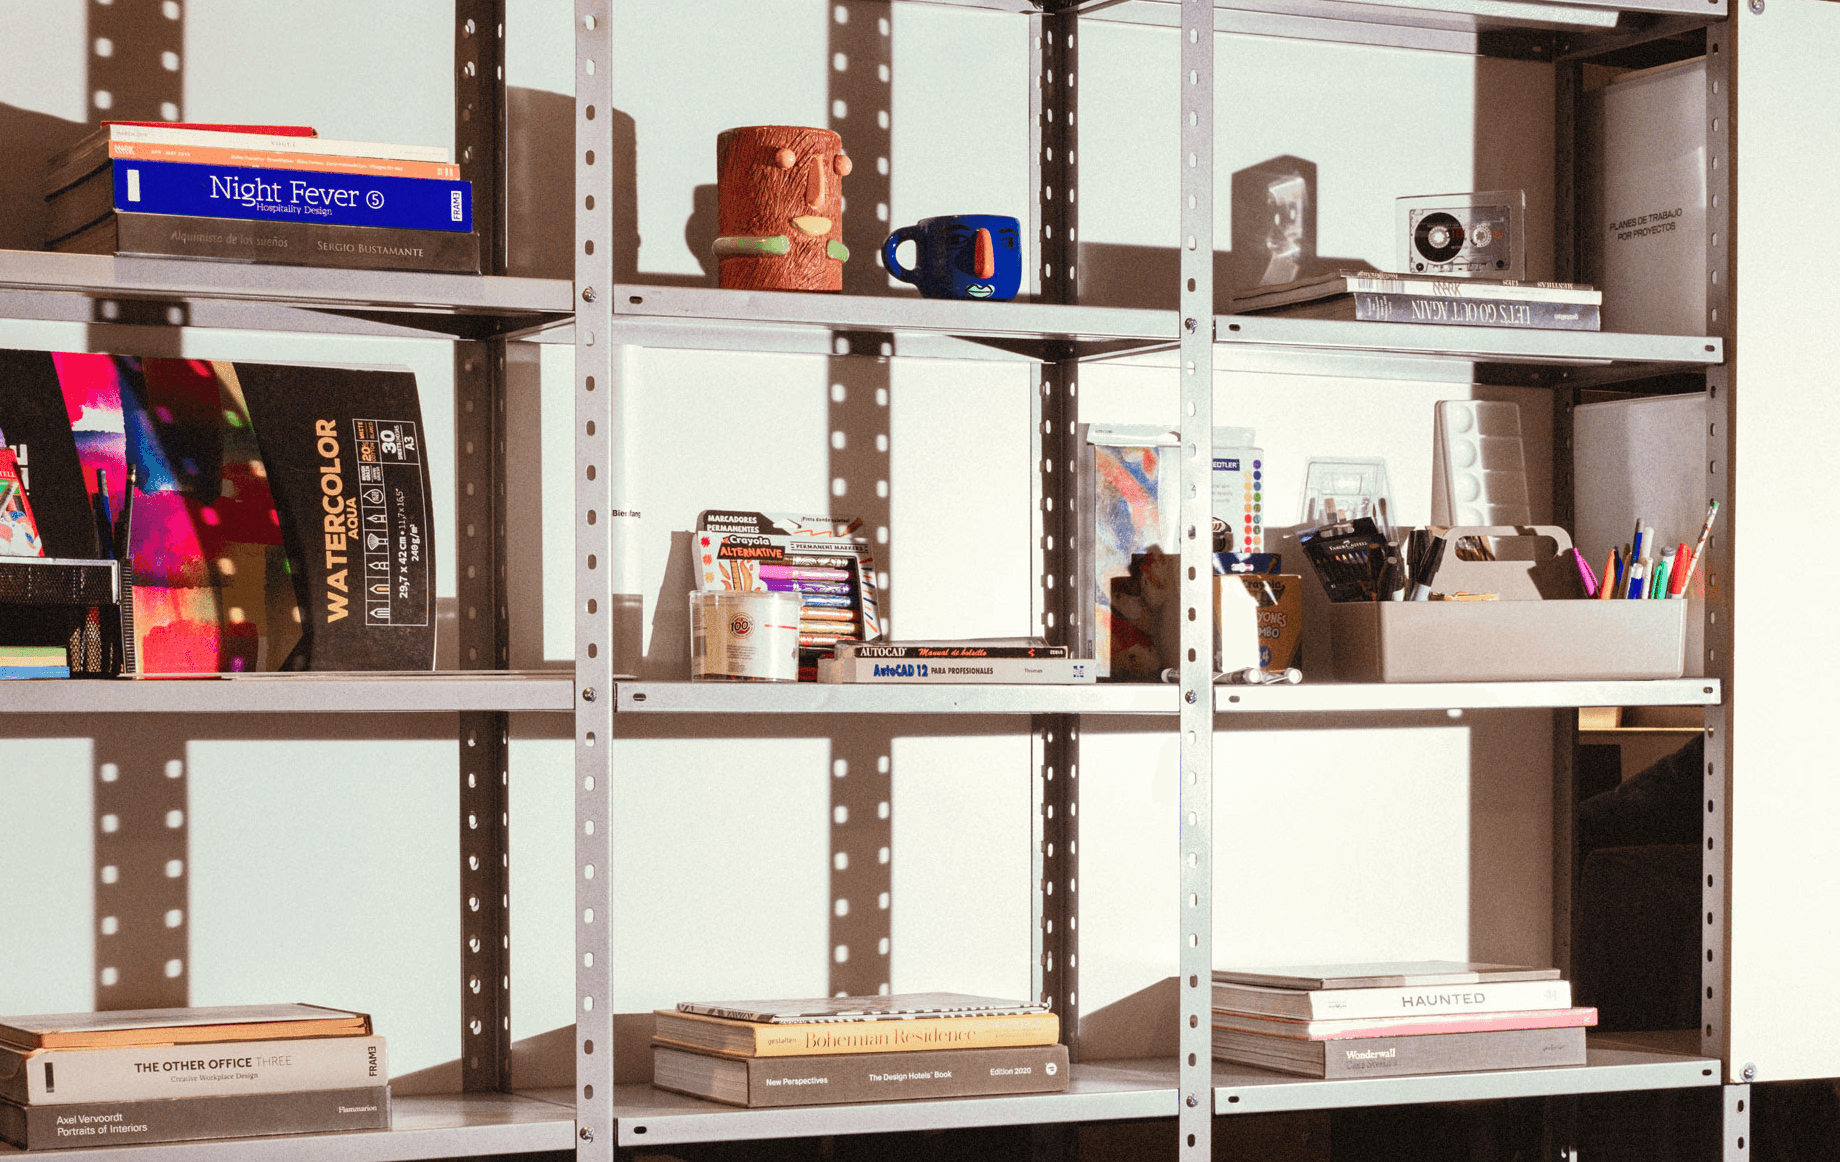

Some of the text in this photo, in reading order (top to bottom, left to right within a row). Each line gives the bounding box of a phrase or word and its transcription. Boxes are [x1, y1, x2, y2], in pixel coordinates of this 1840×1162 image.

[209, 175, 281, 207] Night
[289, 180, 360, 207] Fever
[256, 202, 333, 217] Hospitality Design
[453, 192, 462, 221] FRAME
[1609, 208, 1683, 231] PLANES DE TRABAJO
[1617, 221, 1676, 241] POR PROYECTOS
[358, 244, 424, 258] BUSTAMANTE
[1412, 300, 1449, 320] AGAIN
[1451, 302, 1478, 323] OUT
[1481, 303, 1497, 323] GO
[1500, 305, 1531, 325] LET'S
[380, 429, 397, 454] 30
[404, 436, 415, 451] A3
[315, 419, 349, 624] WATERCOLOR
[347, 497, 359, 540] AQUA
[707, 514, 758, 525] MARCADORES
[706, 524, 760, 534] PERMANENTES
[729, 535, 771, 547] Crayola
[720, 546, 783, 559] ALTERNATIVE
[399, 575, 410, 599] 29,7
[1257, 611, 1287, 628] YONES
[1259, 625, 1280, 639] MBO
[918, 647, 950, 657] Manual
[951, 648, 961, 657] de
[960, 648, 987, 657] bolsillo
[873, 664, 915, 678] AutoCAD
[916, 664, 929, 678] 12
[930, 667, 946, 675] PARA
[947, 667, 994, 675] PROFESIONALES
[1401, 992, 1486, 1008] HAUNTED
[805, 1030, 889, 1050] Bohemian
[894, 1026, 977, 1045] Residence
[1345, 1047, 1396, 1060] Wonderwall
[134, 1055, 293, 1073] THE OTHER OFFICE THREE
[367, 1046, 377, 1077] FRAME
[170, 1072, 259, 1083] Creative Workplace Design
[869, 1073, 882, 1082] The
[883, 1072, 907, 1083] Design
[934, 1070, 952, 1079] Book
[990, 1066, 1032, 1077] Edition 2020
[766, 1077, 829, 1087] New Perspectives
[337, 1104, 378, 1114] Flammarion
[56, 1113, 123, 1125] Axel Vervoordt
[57, 1123, 148, 1137] Portraits of Interiors
